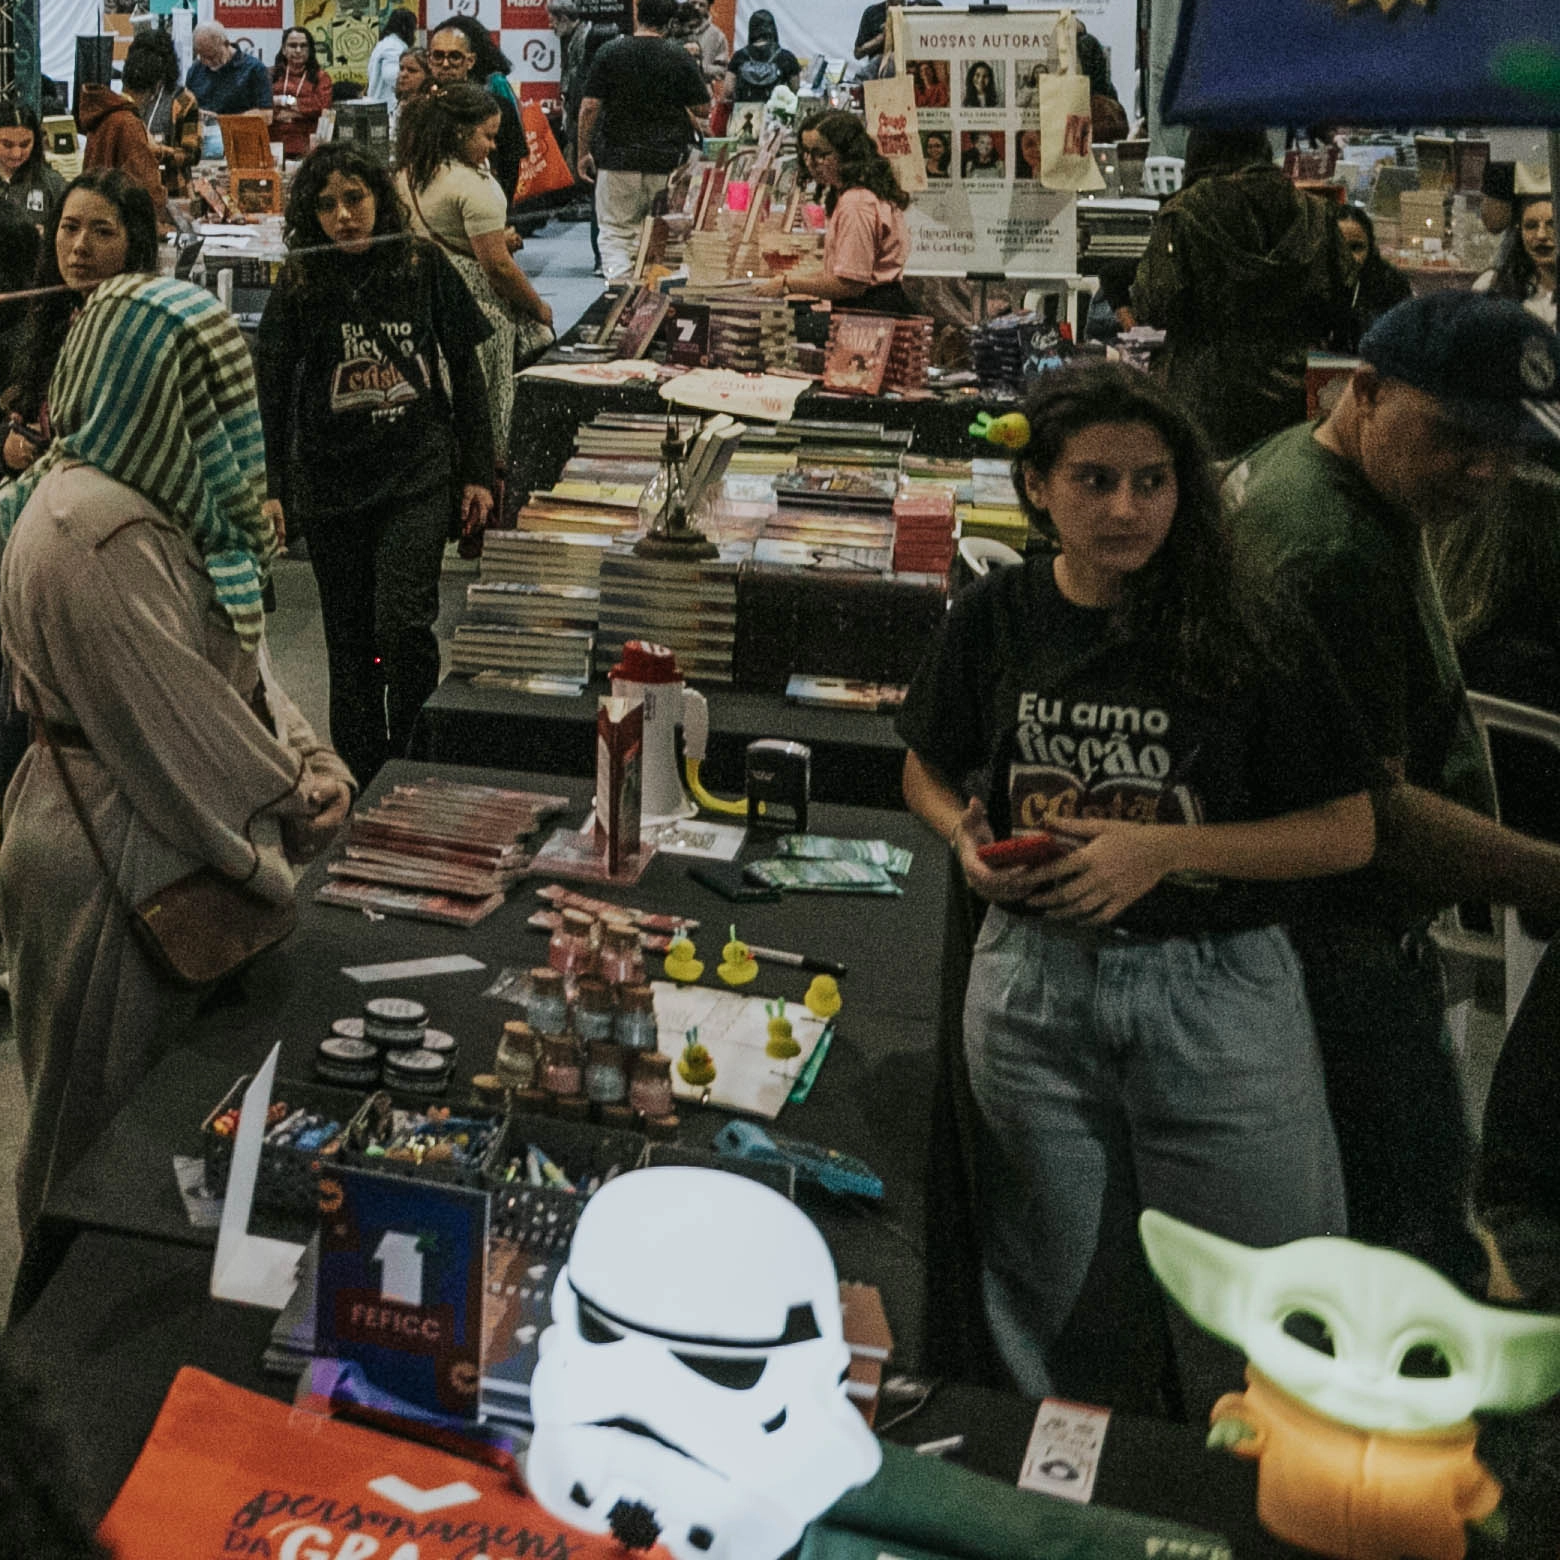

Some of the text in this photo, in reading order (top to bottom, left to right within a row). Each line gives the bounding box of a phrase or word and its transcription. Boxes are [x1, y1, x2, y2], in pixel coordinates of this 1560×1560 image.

[919, 34, 1052, 49] NOSSAS AUTORAS
[341, 321, 412, 339] Eu mo
[1017, 691, 1170, 735] Eu amo
[1017, 721, 1171, 783] ficção
[350, 1302, 442, 1340] FEFICC
[231, 1489, 582, 1560] personagens
